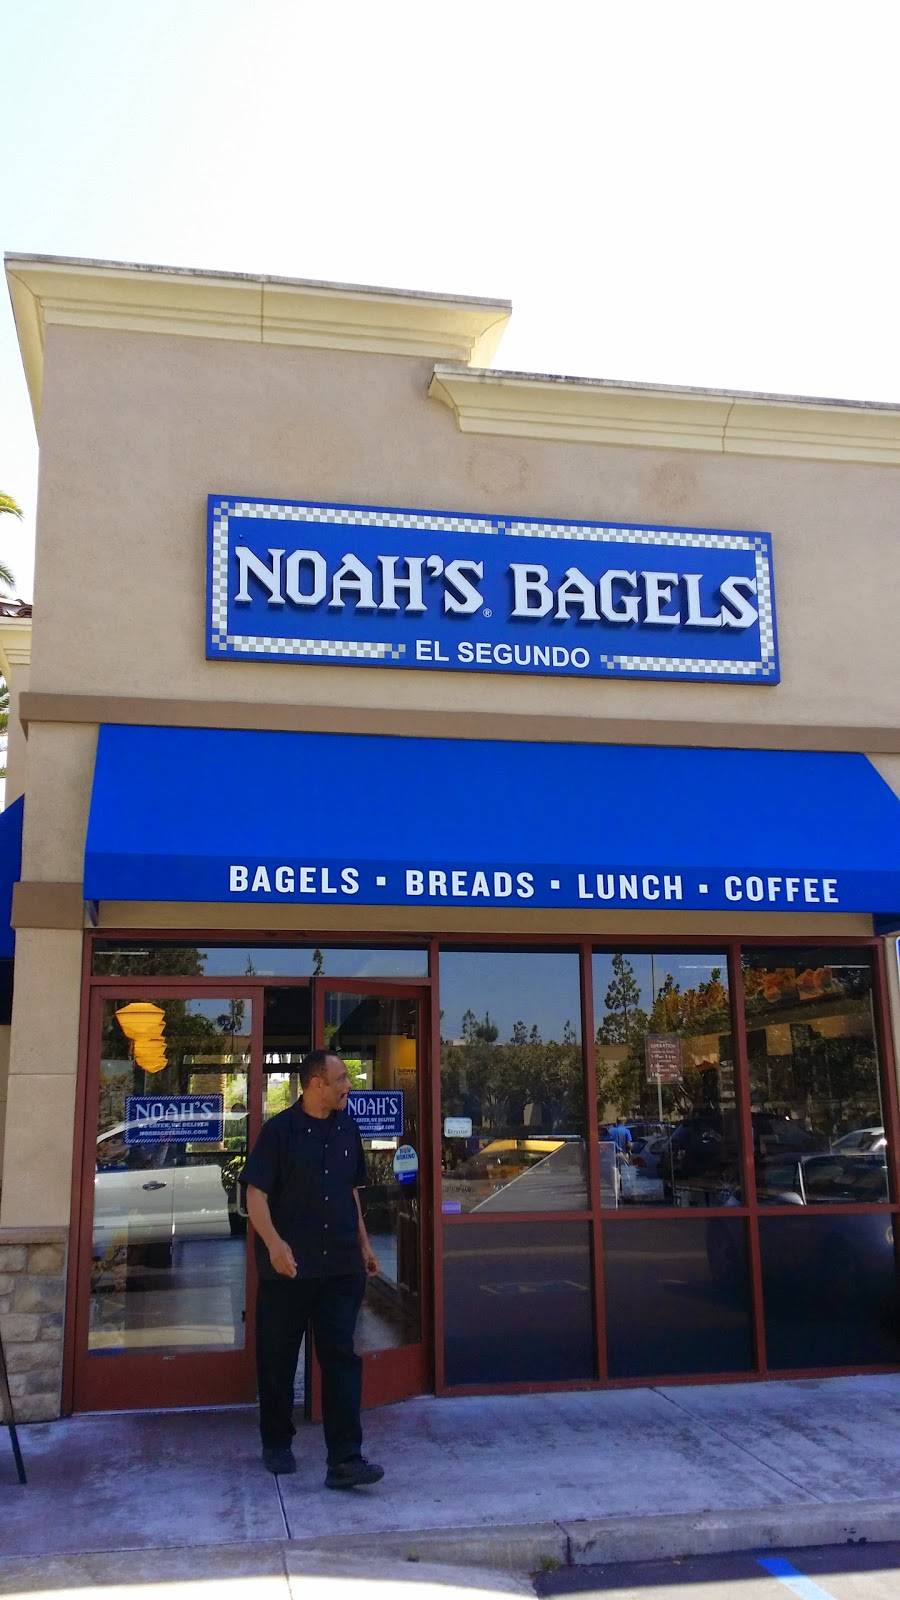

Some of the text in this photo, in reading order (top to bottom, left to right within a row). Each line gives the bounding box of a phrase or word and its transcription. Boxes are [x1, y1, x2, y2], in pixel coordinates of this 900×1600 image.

[234, 546, 758, 629] NOAH'S BAGELS
[415, 639, 590, 668] EL SEGUNDO
[229, 865, 840, 904] BAGELS BREADS LUNCH COFFEE
[136, 1102, 213, 1121] NOAH'S
[347, 1097, 398, 1115] NOAH'S
